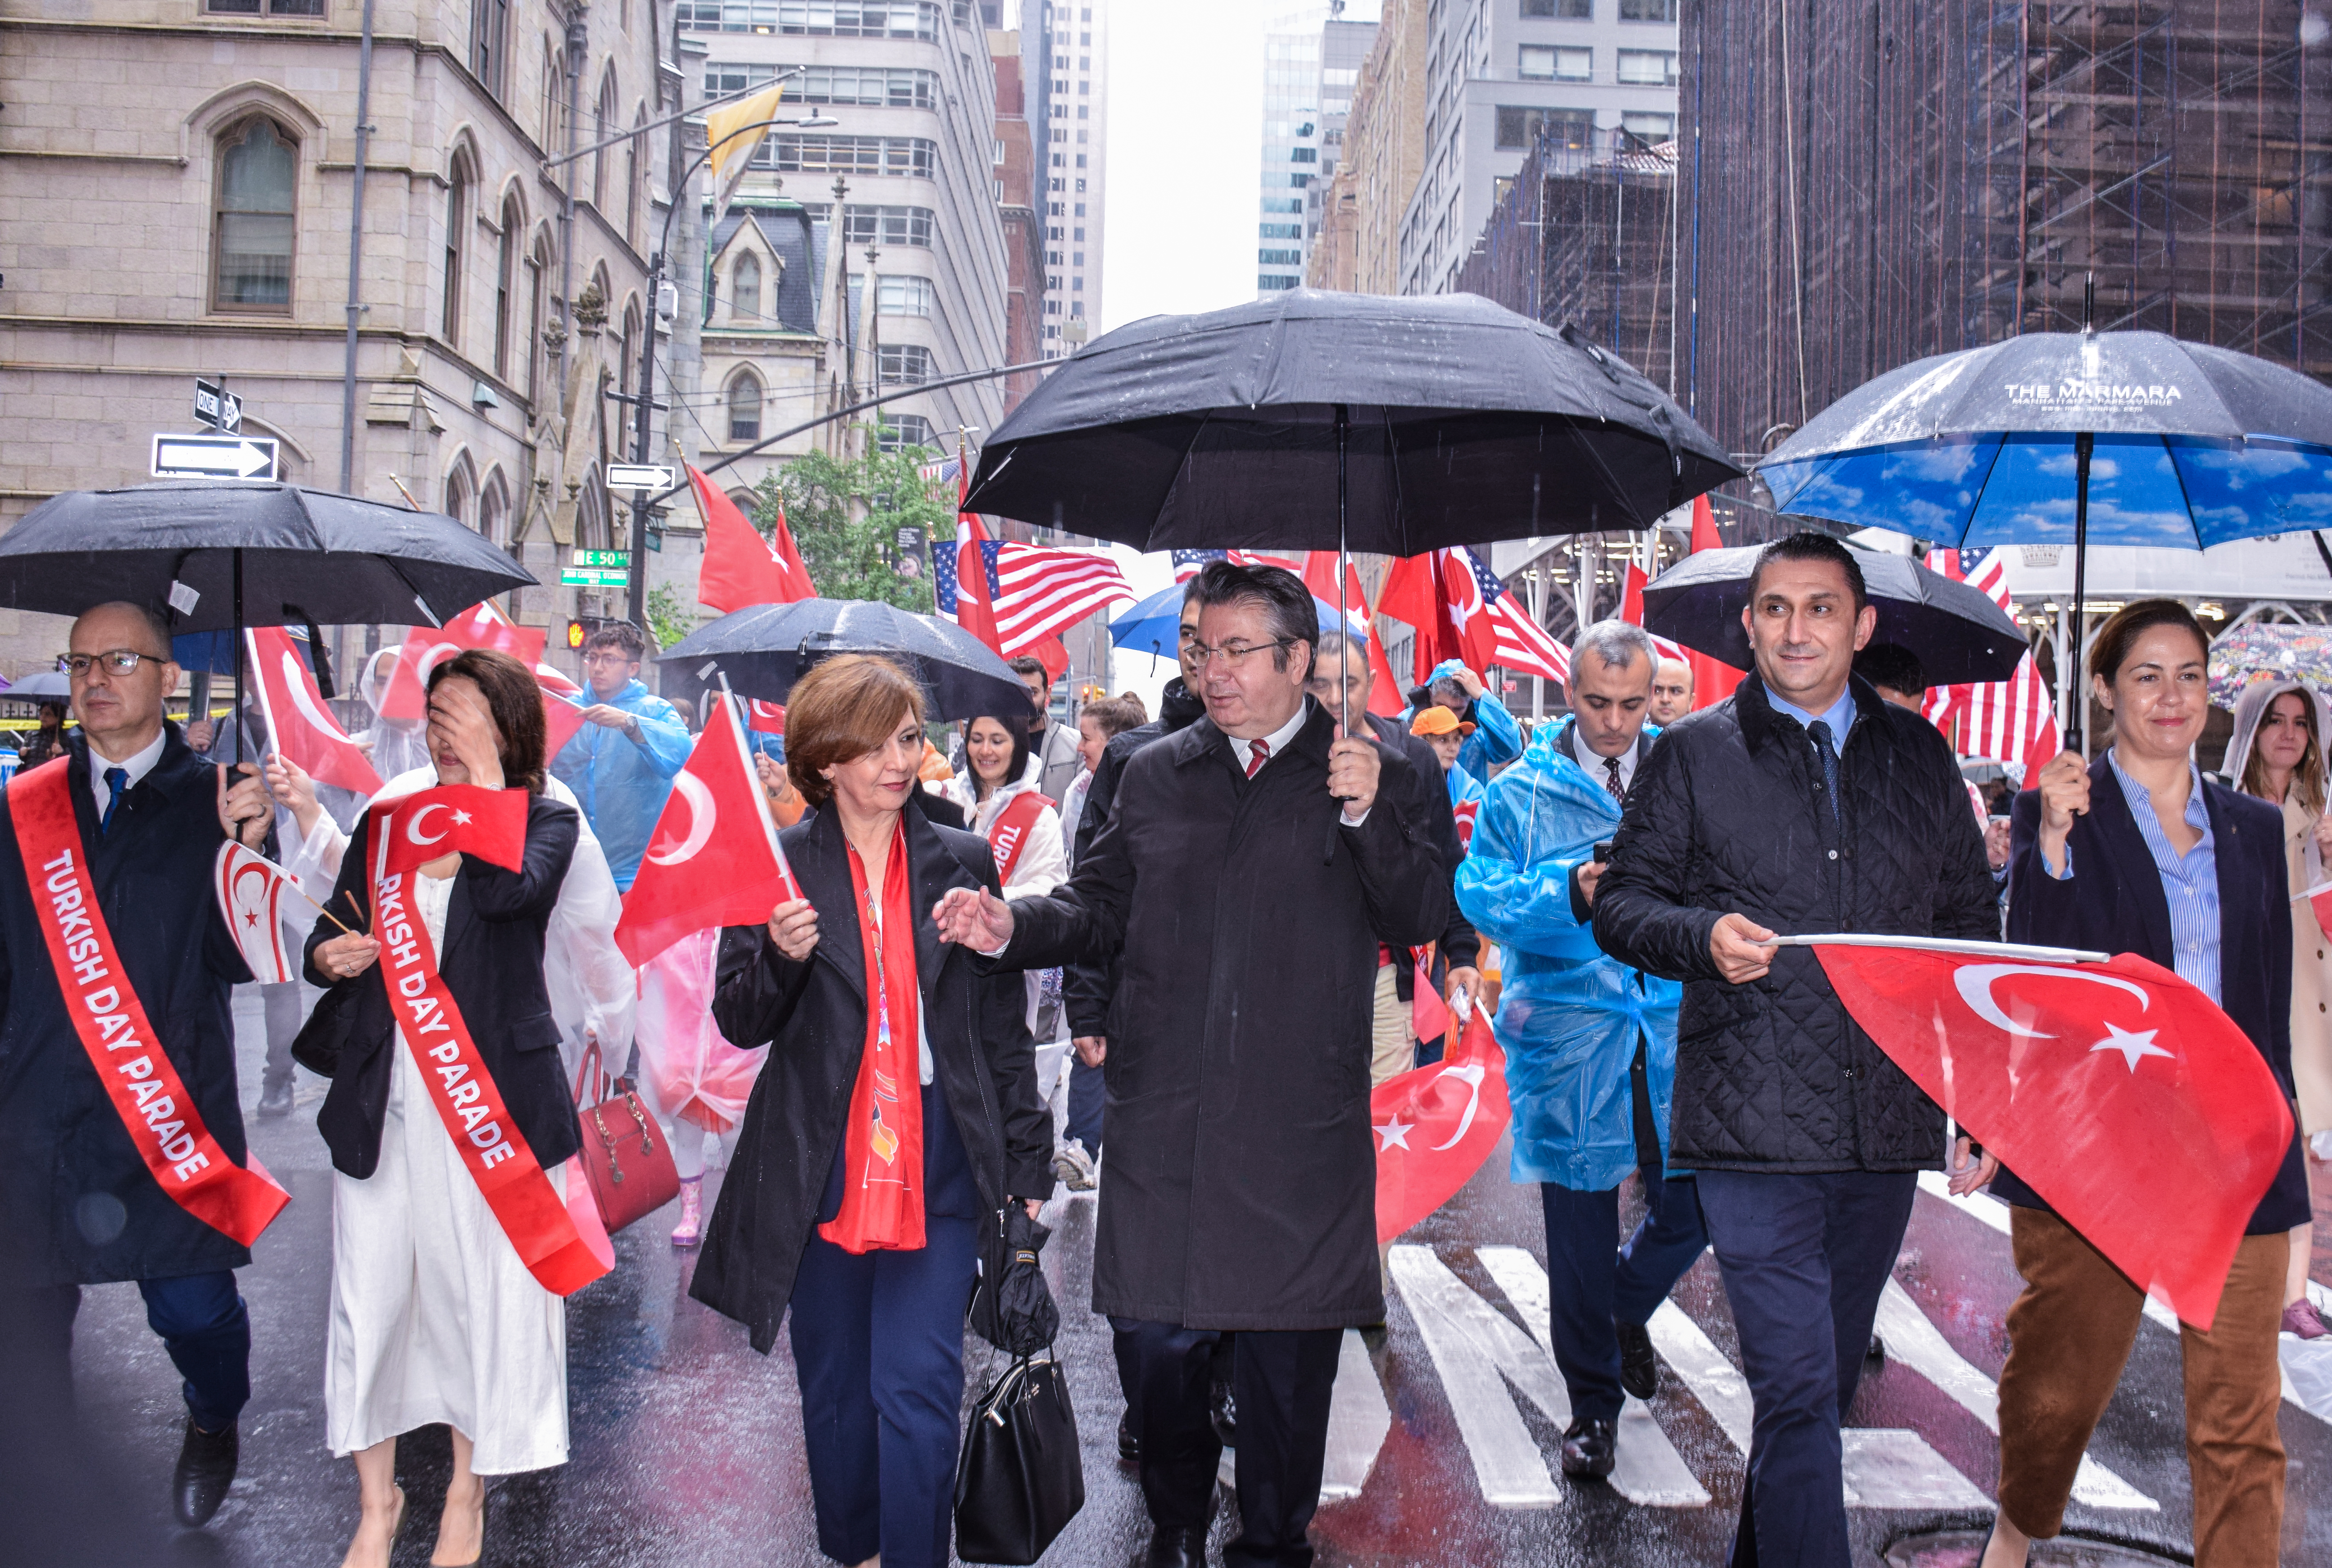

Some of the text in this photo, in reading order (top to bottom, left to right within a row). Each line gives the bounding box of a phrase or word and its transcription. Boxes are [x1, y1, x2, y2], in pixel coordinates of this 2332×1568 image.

[2005, 385, 2181, 399] THE MARMARA
[200, 393, 214, 412] ONE
[586, 552, 594, 564] E
[600, 552, 615, 565] 50
[44, 849, 210, 1182] TURKISH DAY PARADE
[399, 970, 450, 1035] DAY
[429, 1039, 515, 1169] PARADE
